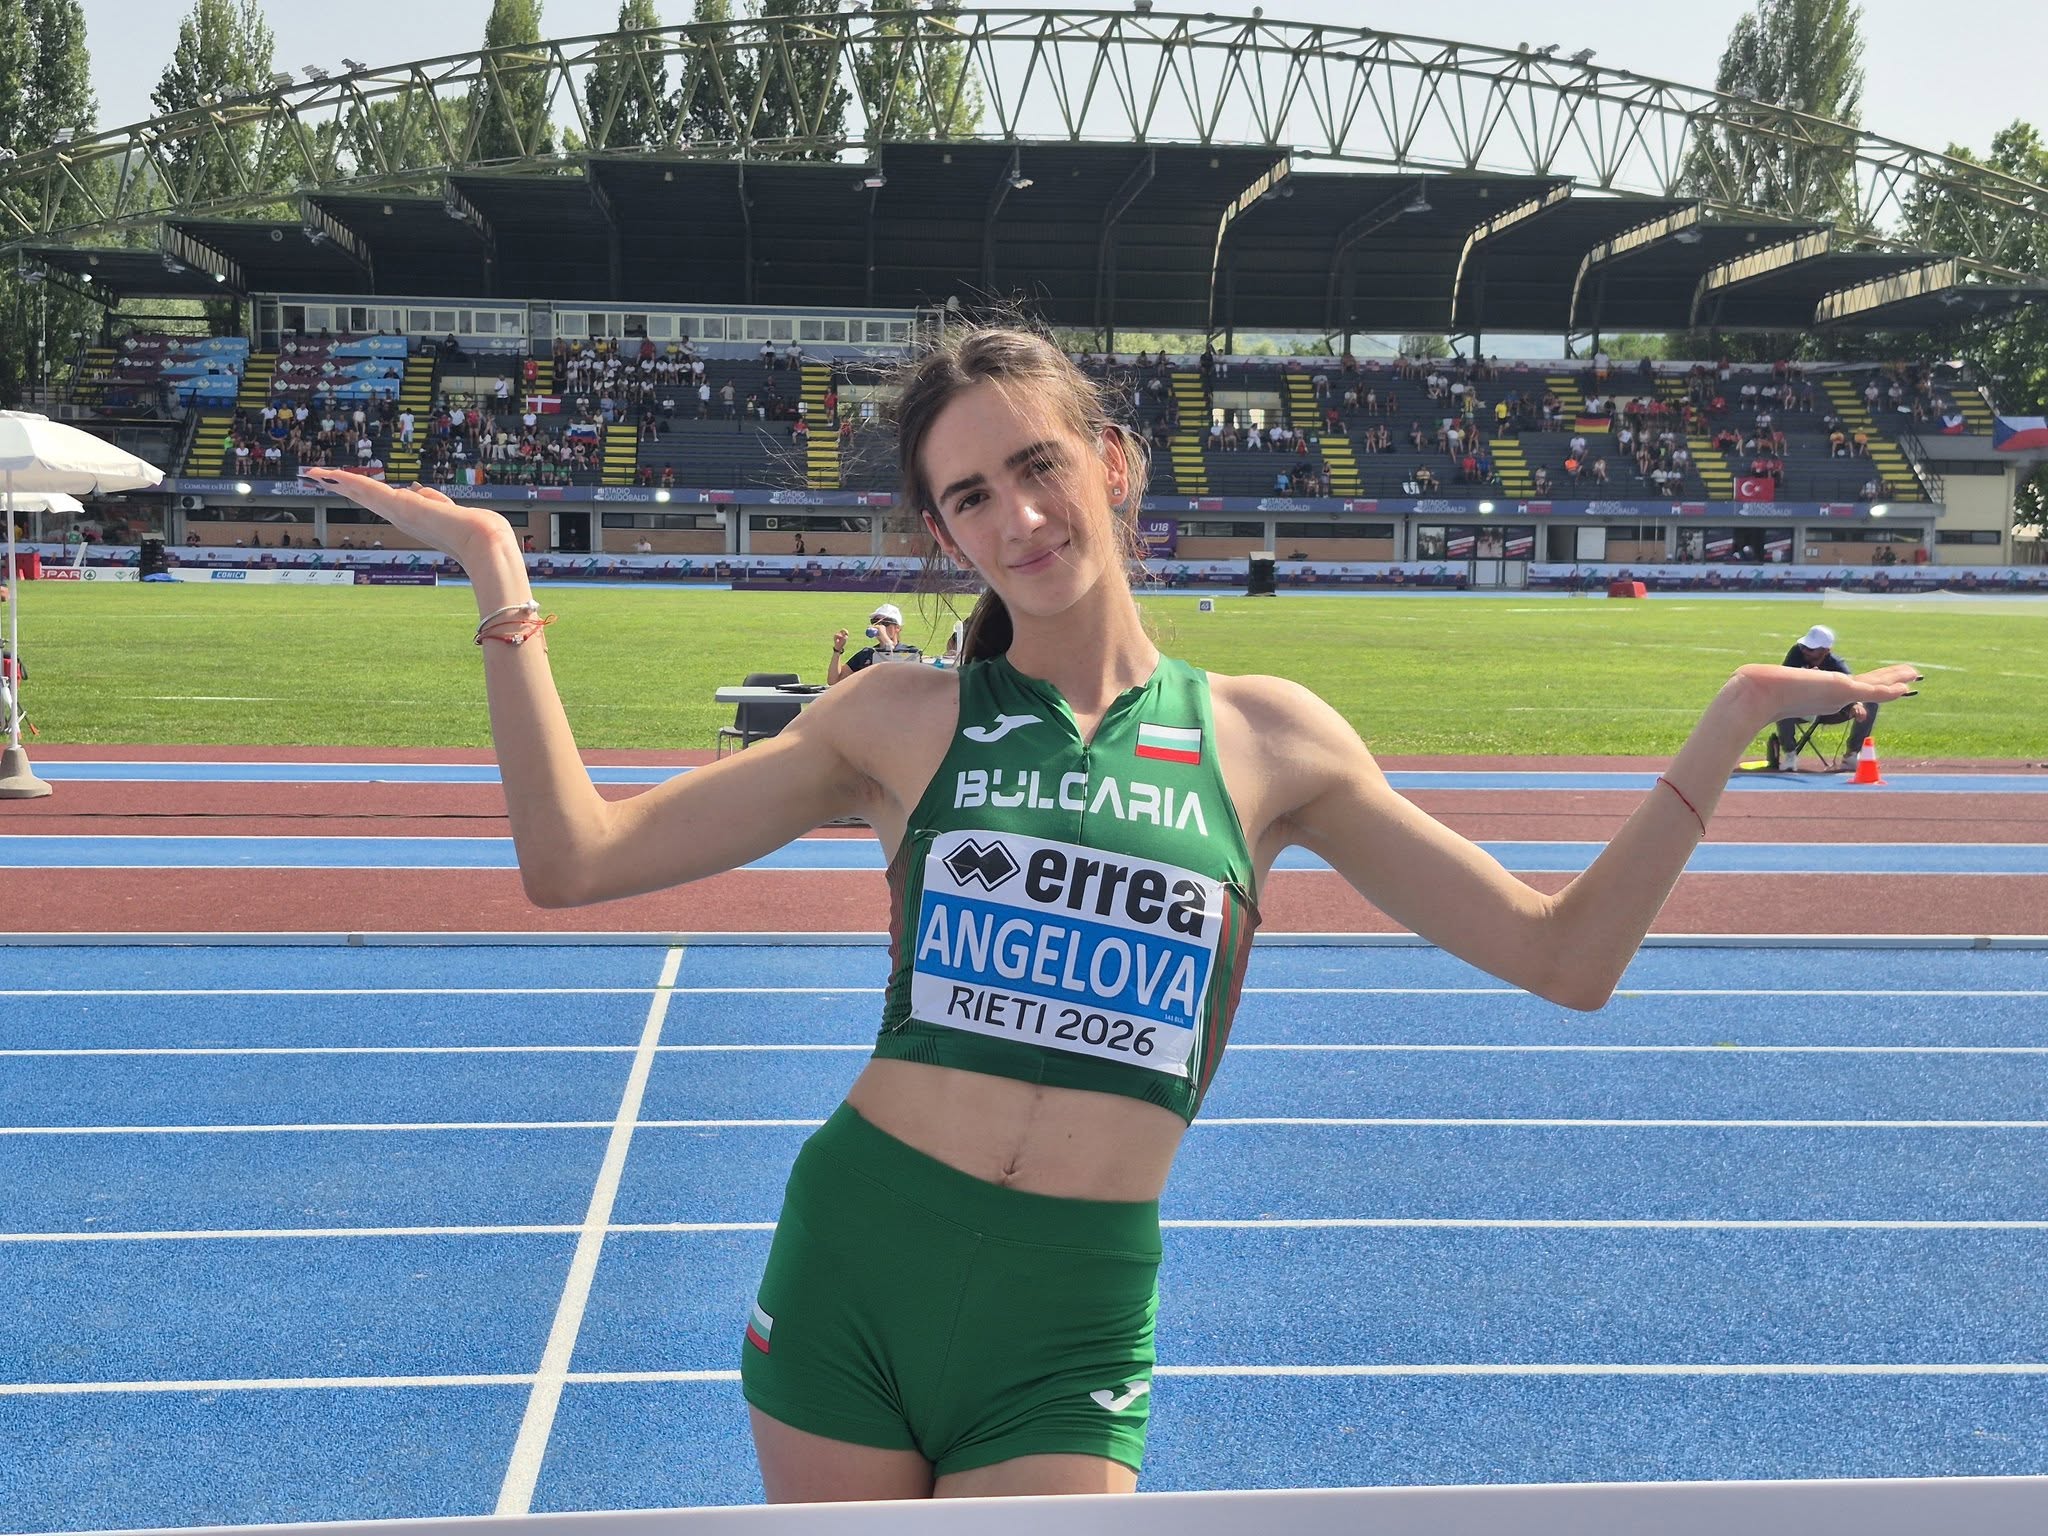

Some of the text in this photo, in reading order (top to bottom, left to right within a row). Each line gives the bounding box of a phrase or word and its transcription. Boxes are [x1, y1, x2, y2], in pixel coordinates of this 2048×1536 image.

[1150, 522, 1169, 532] U18
[216, 571, 245, 579] CONICA
[953, 769, 1208, 836] BULGARIA
[1025, 848, 1207, 938] errea
[918, 904, 1194, 1016] ANGELOVA
[947, 985, 1157, 1057] RIETI 2026
